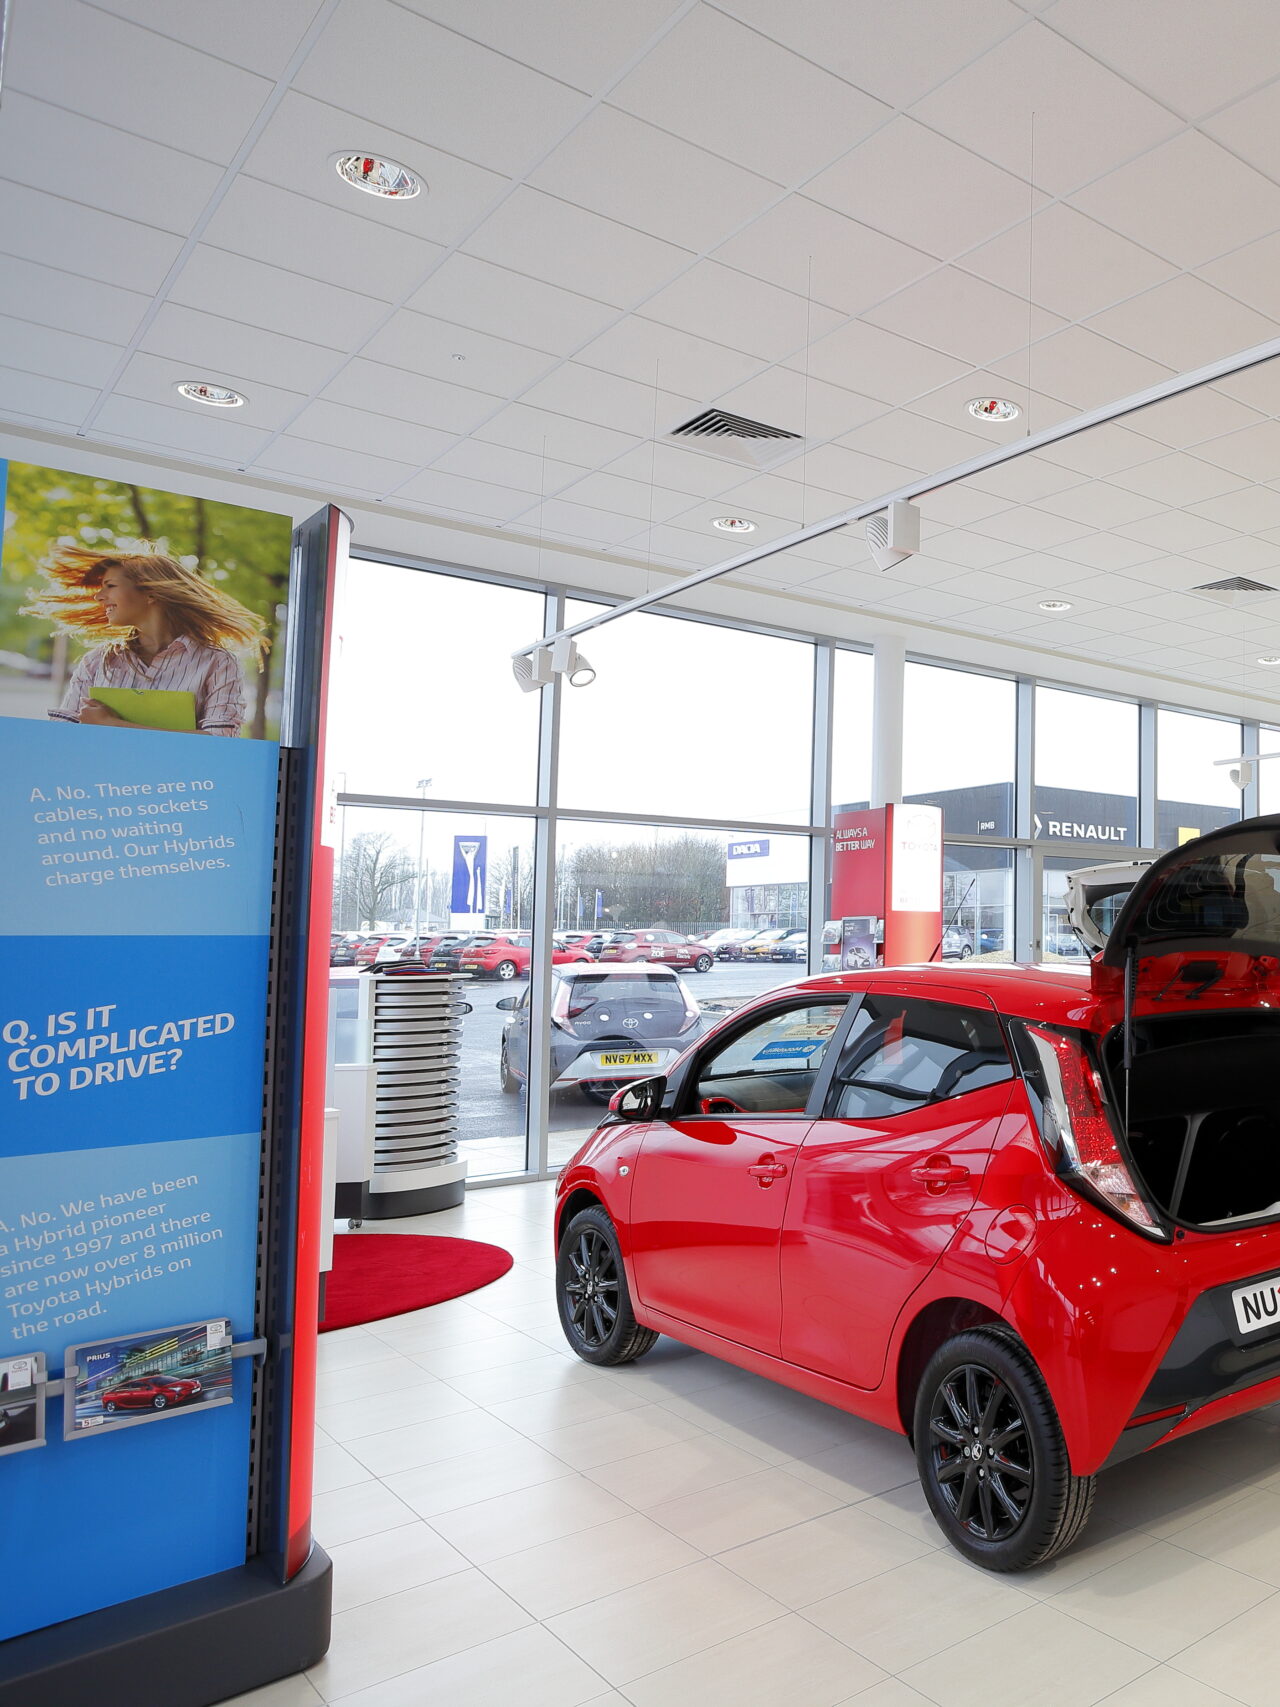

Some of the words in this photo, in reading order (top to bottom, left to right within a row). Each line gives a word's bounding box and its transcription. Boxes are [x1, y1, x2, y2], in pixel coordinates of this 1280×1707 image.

[30, 788, 51, 802] A.
[57, 786, 91, 800] No.
[95, 783, 151, 798] There
[157, 781, 186, 793] are
[191, 779, 214, 792] no
[34, 806, 103, 824] cables,
[108, 805, 132, 818] no
[137, 799, 209, 816] sockets
[981, 821, 995, 831] RMB
[38, 828, 76, 845] and
[81, 827, 106, 841] no
[112, 821, 183, 839] waiting
[835, 840, 860, 852] BETTER
[860, 839, 875, 849] WAY
[836, 828, 861, 840] ALWAYS
[862, 827, 868, 836] A
[1049, 821, 1127, 841] RENAULT
[41, 846, 119, 866] around.
[124, 843, 160, 857] Our
[164, 835, 235, 856] Hybrids
[46, 870, 115, 887] charge
[119, 857, 230, 879] themselves.
[2, 1020, 37, 1047] Q.
[47, 1011, 77, 1037] IS
[87, 1004, 117, 1030] IT
[8, 1012, 236, 1073] COMPLICATED
[605, 1055, 631, 1064] NV67
[633, 1054, 653, 1063] MXX
[12, 1072, 61, 1101] TO
[69, 1048, 183, 1090] DRIVE?
[20, 1212, 57, 1228] No.
[60, 1200, 96, 1218] We
[100, 1188, 147, 1208] have
[152, 1175, 198, 1195] been
[14, 1221, 86, 1251] Hybrid
[91, 1203, 167, 1235] pioneer
[0, 1253, 56, 1278] since
[62, 1235, 113, 1261] 1997
[120, 1223, 156, 1245] and
[160, 1212, 211, 1234] there
[4, 1280, 39, 1298] are
[45, 1266, 89, 1287] now
[94, 1252, 139, 1273] over
[144, 1245, 156, 1259] 8
[161, 1228, 224, 1254] million
[7, 1289, 81, 1318] Toyota
[86, 1265, 163, 1296] Hybrids
[168, 1258, 192, 1272] on
[11, 1320, 49, 1340] the
[53, 1301, 108, 1328] road.
[86, 1352, 111, 1362] PRIUS
[83, 1419, 90, 1428] 5
